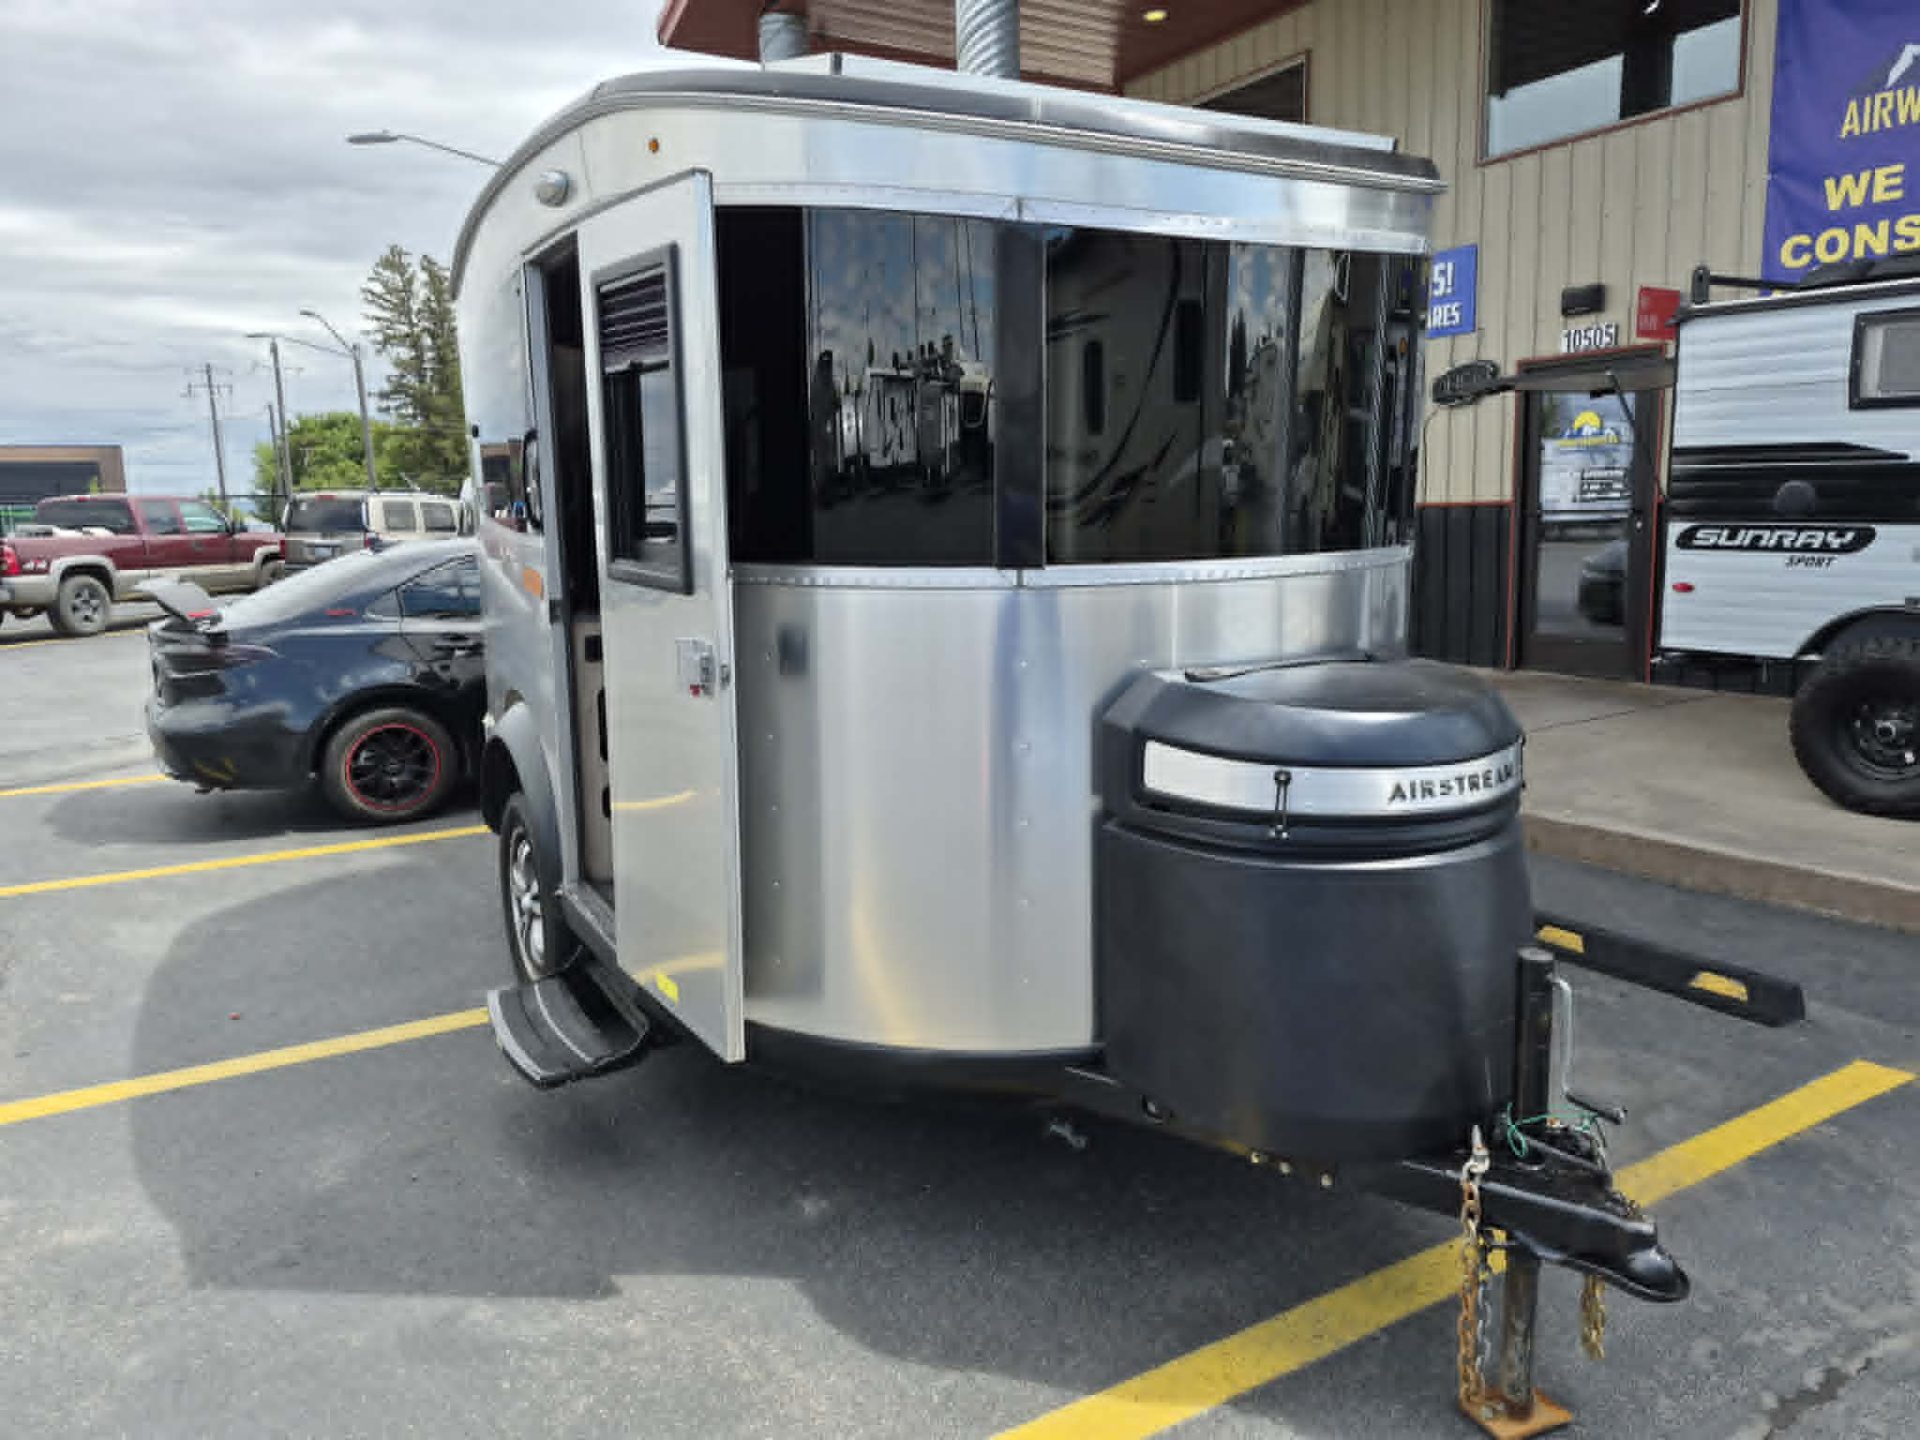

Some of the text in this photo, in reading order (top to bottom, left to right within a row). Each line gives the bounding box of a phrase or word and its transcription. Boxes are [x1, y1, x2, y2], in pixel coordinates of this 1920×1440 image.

[1841, 86, 1920, 137] AIRW
[1824, 164, 1905, 211] WE
[1780, 214, 1920, 268] CONS
[1692, 528, 1855, 548] SUNRAY
[1785, 555, 1836, 569] SPORT
